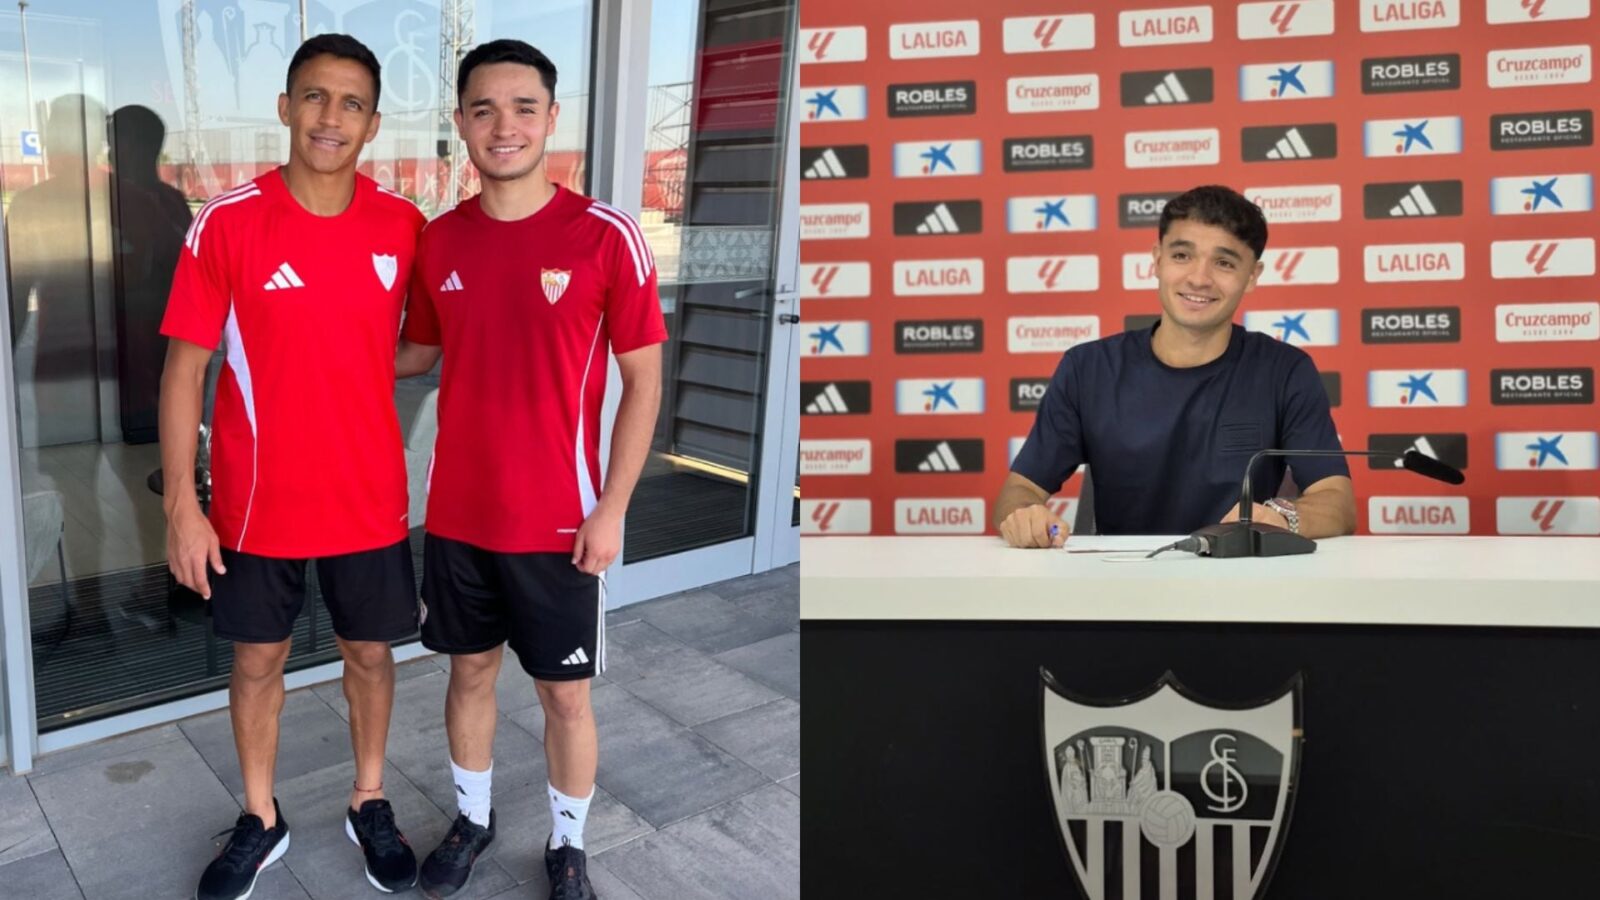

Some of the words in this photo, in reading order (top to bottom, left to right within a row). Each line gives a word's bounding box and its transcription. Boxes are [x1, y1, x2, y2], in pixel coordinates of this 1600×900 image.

[1371, 0, 1448, 23] LALIGA
[1130, 15, 1202, 38] LALIGA
[901, 30, 967, 50] LALIGA
[1371, 61, 1450, 80] ROBLES
[1496, 54, 1583, 76] Cruzcampo
[895, 87, 968, 105] ROBLES
[1015, 83, 1091, 102] Cruzcampo
[1500, 118, 1583, 136] ROBLES
[1011, 143, 1085, 160] ROBLES
[1134, 136, 1213, 157] Cruzcampo
[1127, 198, 1167, 216] ROB
[1253, 192, 1333, 213] Cruzcampo
[800, 211, 861, 230] ruzcampo
[1375, 252, 1452, 274] LALIGA
[904, 268, 972, 289] LALIGA
[1371, 313, 1451, 331] ROBLES
[1504, 312, 1590, 334] Cruzcampo
[903, 325, 975, 341] ROBLES
[1016, 324, 1092, 344] Cruzcampo
[1500, 374, 1584, 391] ROBLES
[800, 448, 863, 466] ruzcampo
[906, 506, 973, 525] LALIGA
[1381, 506, 1456, 525] LALIGA
